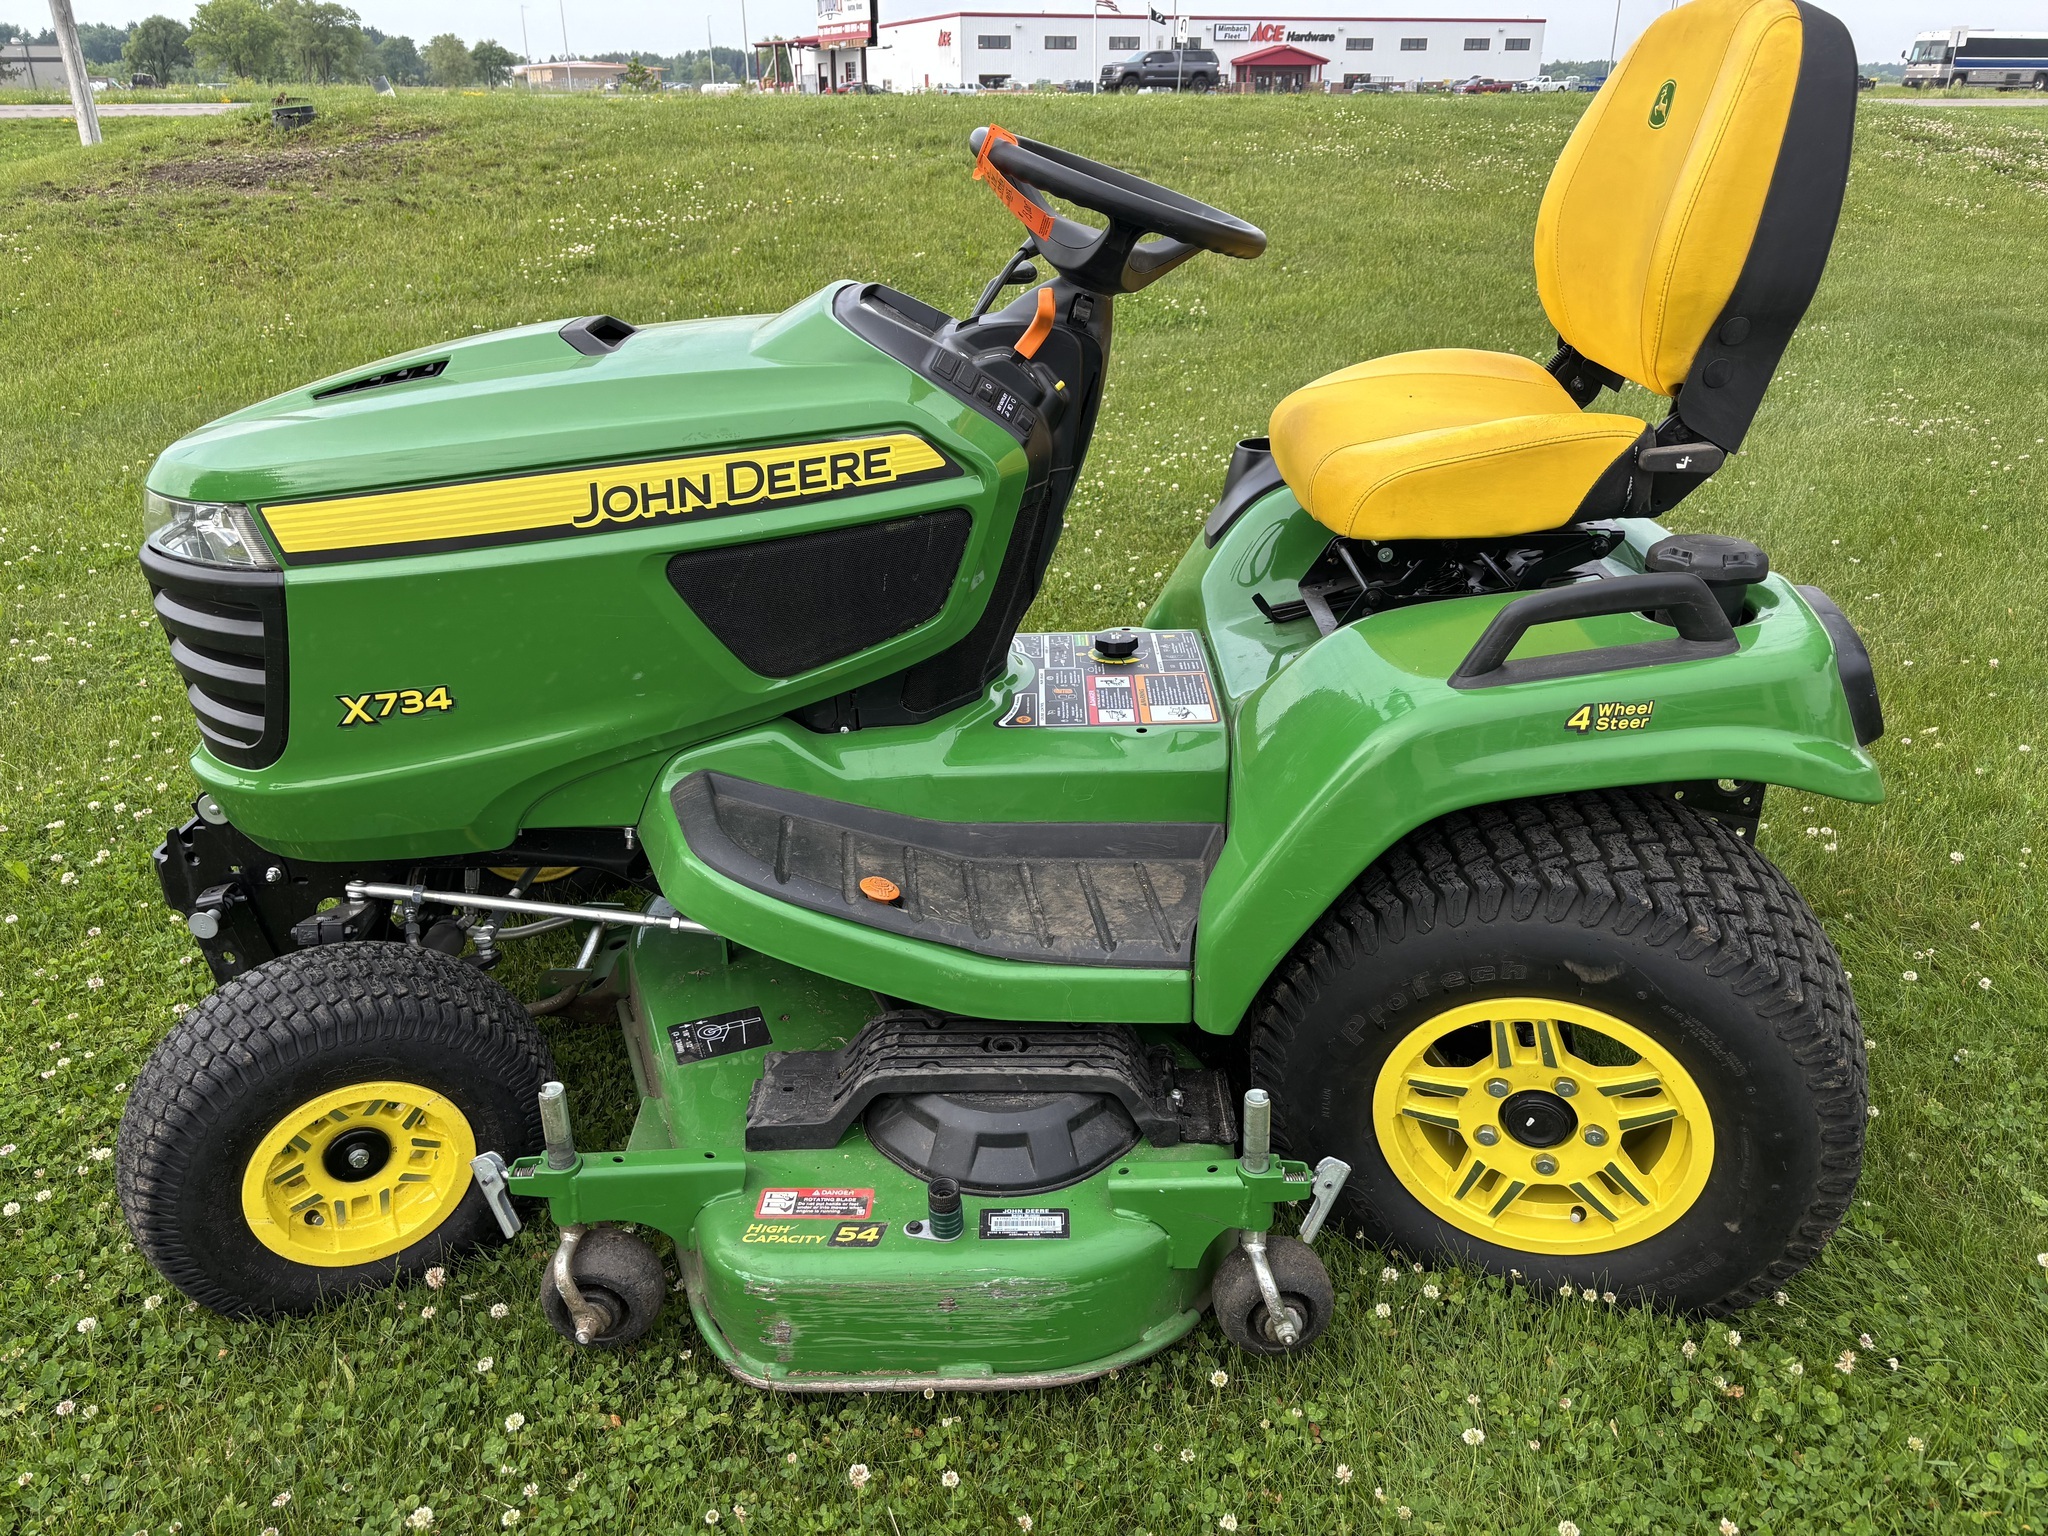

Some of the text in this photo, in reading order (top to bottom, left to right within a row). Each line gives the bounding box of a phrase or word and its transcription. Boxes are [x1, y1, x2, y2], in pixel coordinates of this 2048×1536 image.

[938, 29, 952, 47] ACE
[1217, 25, 1248, 33] Mimbach
[1223, 32, 1241, 40] Fleet
[1250, 22, 1336, 42] ACE Hardware
[572, 445, 894, 525] JOHN DEERE
[337, 686, 454, 726] X734
[1566, 700, 1655, 731] 4 Wheel
[1594, 716, 1651, 731] Steer
[1340, 960, 1527, 1047] ProTech
[742, 1234, 827, 1244] CAPACITY
[746, 1224, 880, 1242] HIGH 54
